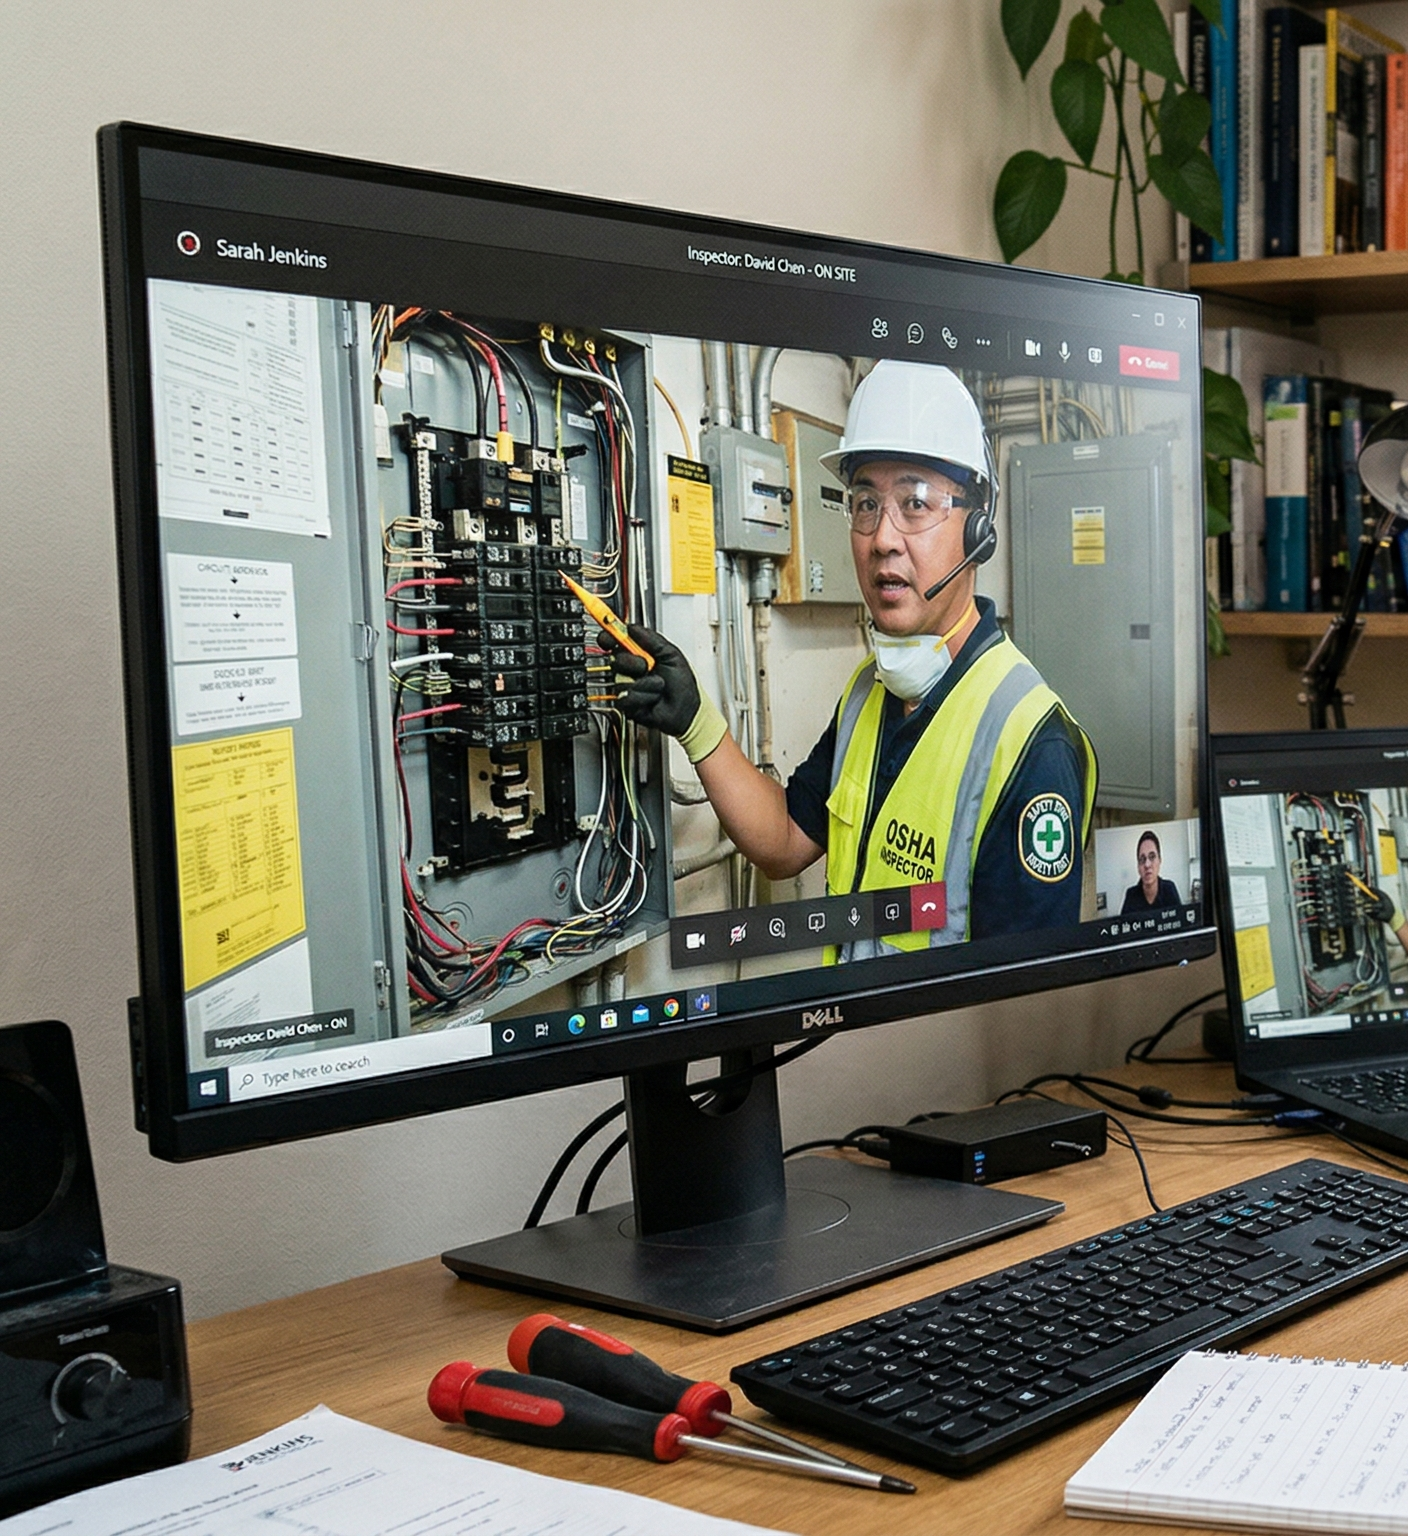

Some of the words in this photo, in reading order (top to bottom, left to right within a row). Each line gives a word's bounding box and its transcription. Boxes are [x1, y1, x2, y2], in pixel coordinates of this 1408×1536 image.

[216, 239, 265, 262] Sarah
[268, 245, 328, 269] Jenkins
[744, 253, 775, 271] David
[777, 258, 805, 275] Chen
[814, 263, 832, 279] ON
[834, 266, 857, 282] SITE
[886, 818, 935, 865] OSHA
[330, 1017, 348, 1029] ON
[802, 1005, 844, 1030] DELL
[262, 1072, 289, 1087] Type
[292, 1067, 318, 1080] here
[321, 1064, 332, 1075] to
